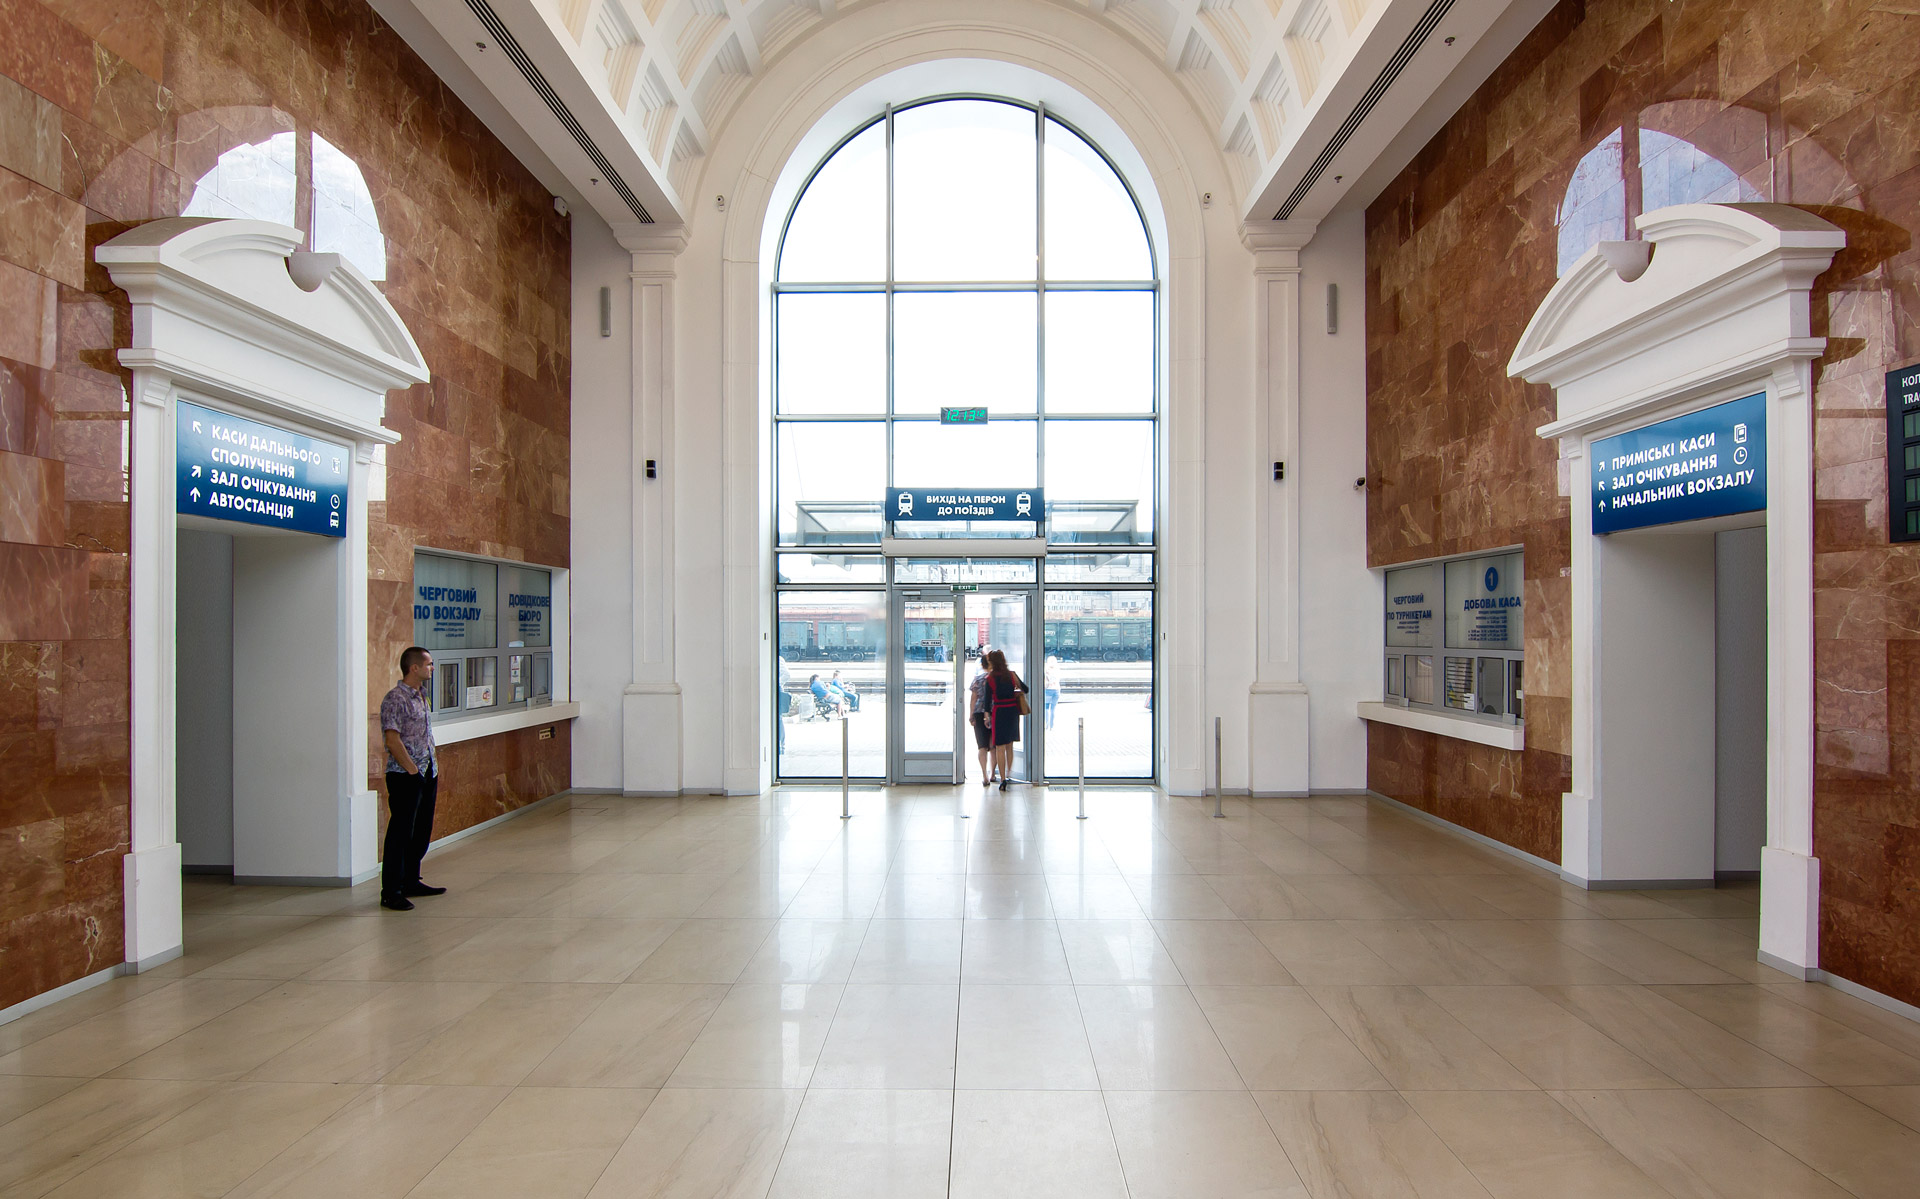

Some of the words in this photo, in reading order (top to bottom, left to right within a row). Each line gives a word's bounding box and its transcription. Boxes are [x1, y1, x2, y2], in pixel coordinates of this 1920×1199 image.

[1903, 391, 1920, 404] TRA
[212, 424, 247, 446] КАСИ
[250, 435, 321, 465] ДАЛЬНЬОГО
[1612, 442, 1675, 470] ПРИМІСЬКІ
[1680, 432, 1715, 454] КАСИ
[211, 447, 295, 479] СПОЛУЧЕННЯ
[1612, 473, 1634, 490] ЗАЛ
[1636, 454, 1718, 484] ОЧІКУВАННЯ
[210, 469, 238, 488] ЗАЛ
[241, 475, 317, 503] ОЧІКУВАННЯ
[1612, 483, 1684, 509] НАЧАЛЬНИК
[1687, 469, 1755, 495] ВОКЗАЛУ
[209, 491, 294, 520] АВТОСТАНЦІЯ
[926, 495, 956, 504] ВИХІД
[958, 495, 972, 504] НА
[973, 495, 1006, 504] ПЕРОН
[937, 506, 953, 516] ДО
[955, 504, 994, 516] ПОЇЗДІВ
[419, 586, 477, 603] ЧЕРГОВИЙ
[509, 593, 550, 608] ДОВІДКОВЕ
[1394, 593, 1424, 605] ЧЕРГОВИЙ
[1464, 599, 1496, 611] ДОБОВА
[1499, 596, 1522, 608] КАСА
[414, 605, 430, 620] ПО
[433, 606, 481, 621] ВОКЗАЛУ
[518, 609, 542, 622] БЮРО
[1387, 612, 1395, 620] ПО
[1396, 610, 1432, 620] ТУРНІКЕТАМ
